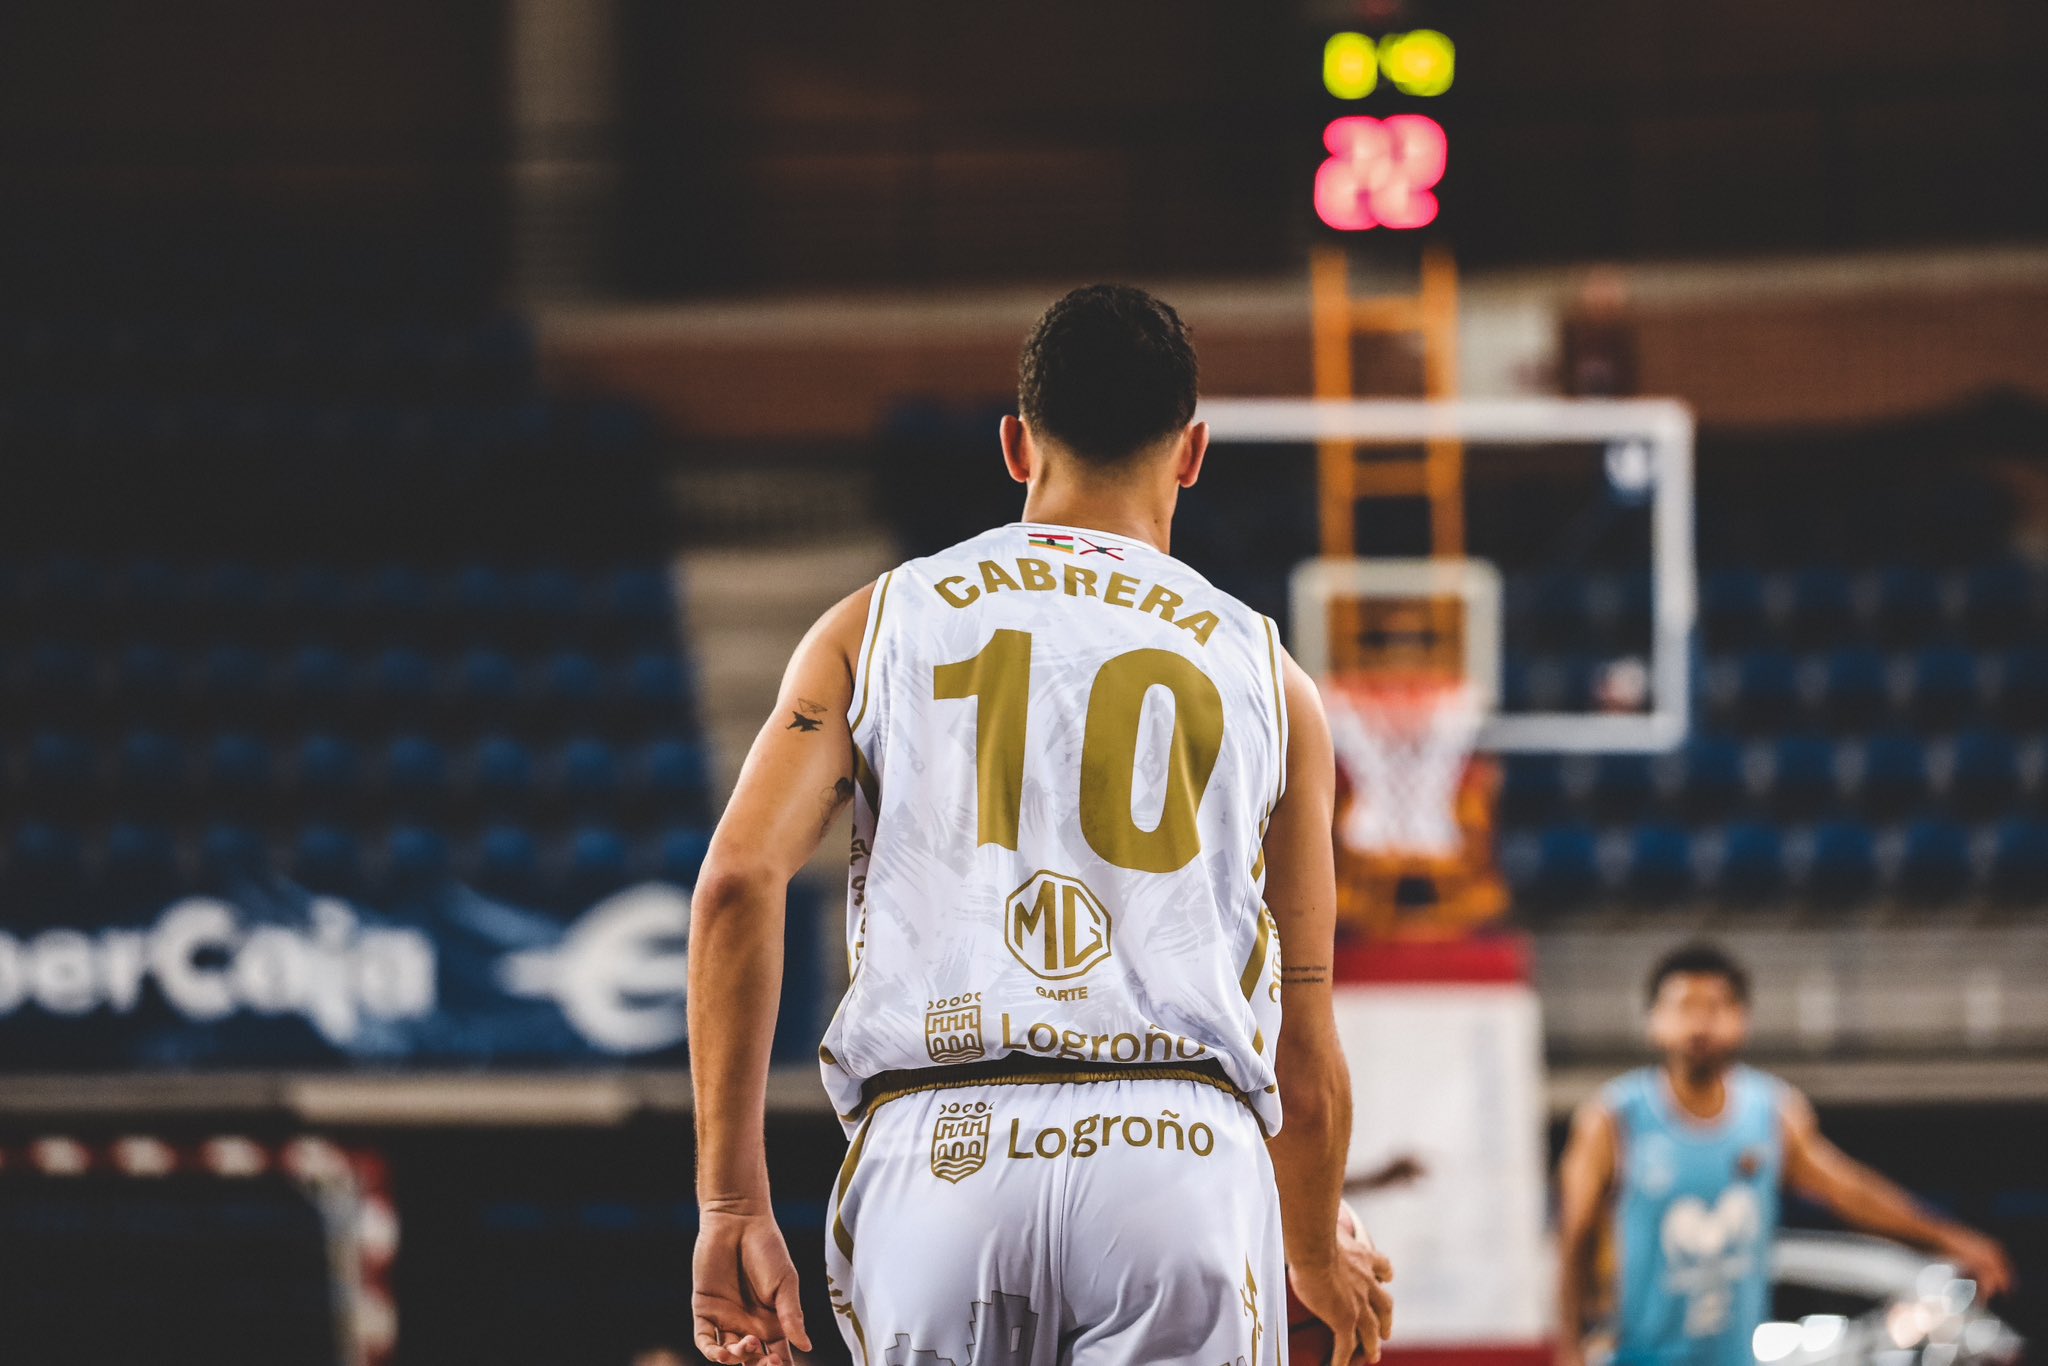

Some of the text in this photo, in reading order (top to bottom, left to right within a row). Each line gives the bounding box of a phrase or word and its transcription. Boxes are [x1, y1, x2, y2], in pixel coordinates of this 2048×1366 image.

[934, 558, 1220, 646] CABRERA
[933, 628, 1225, 874] 10
[1012, 877, 1107, 973] MG
[1035, 985, 1089, 1002] GARTE
[1007, 1109, 1215, 1160] Logroño
